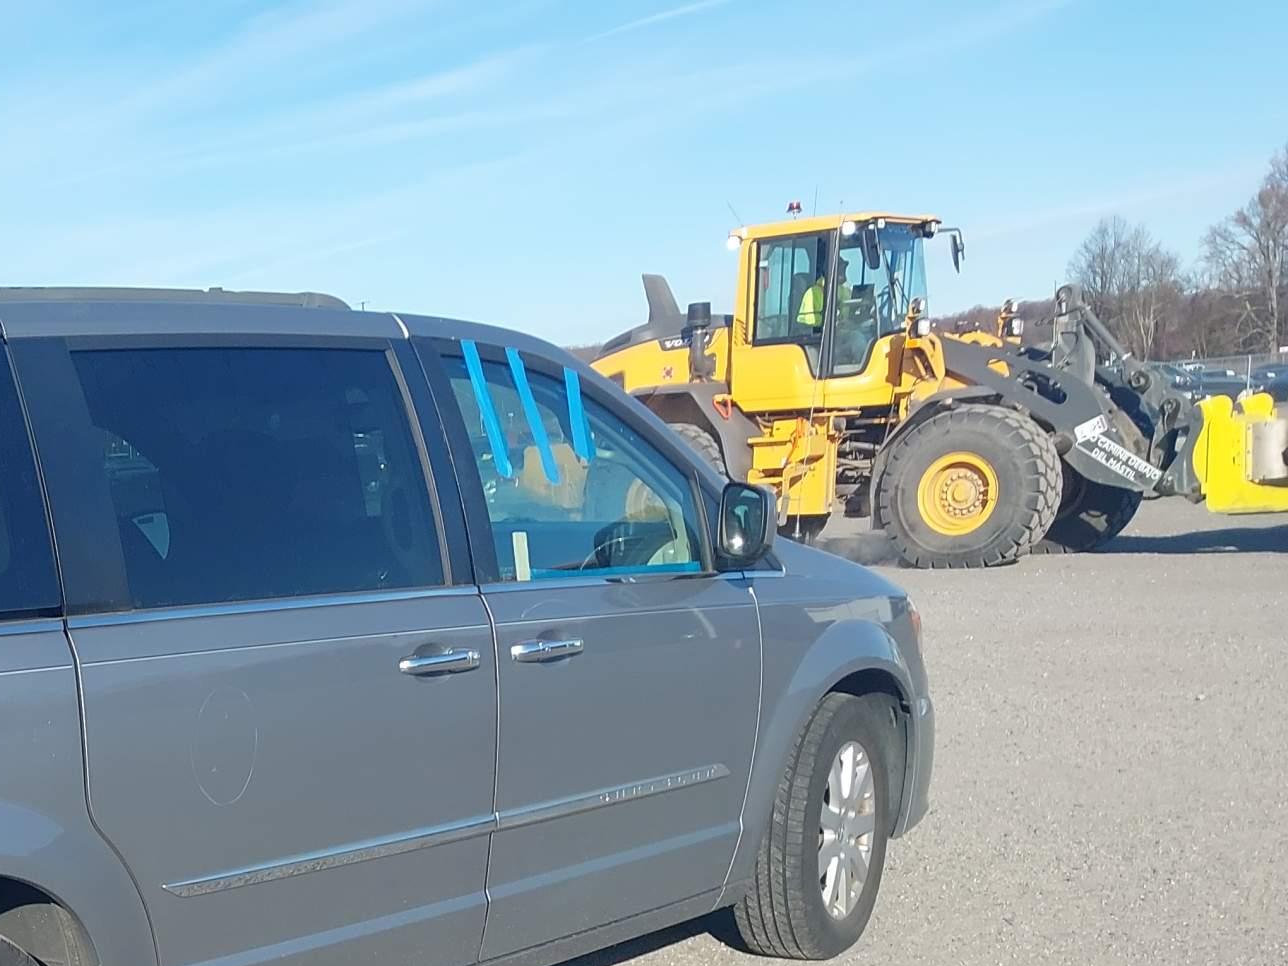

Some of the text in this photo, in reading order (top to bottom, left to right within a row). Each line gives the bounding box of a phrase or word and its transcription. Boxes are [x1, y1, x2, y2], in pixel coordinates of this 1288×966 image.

[1091, 447, 1109, 464] DEL
[1097, 438, 1129, 462] CAMINE
[1128, 455, 1161, 480] DEBAJO
